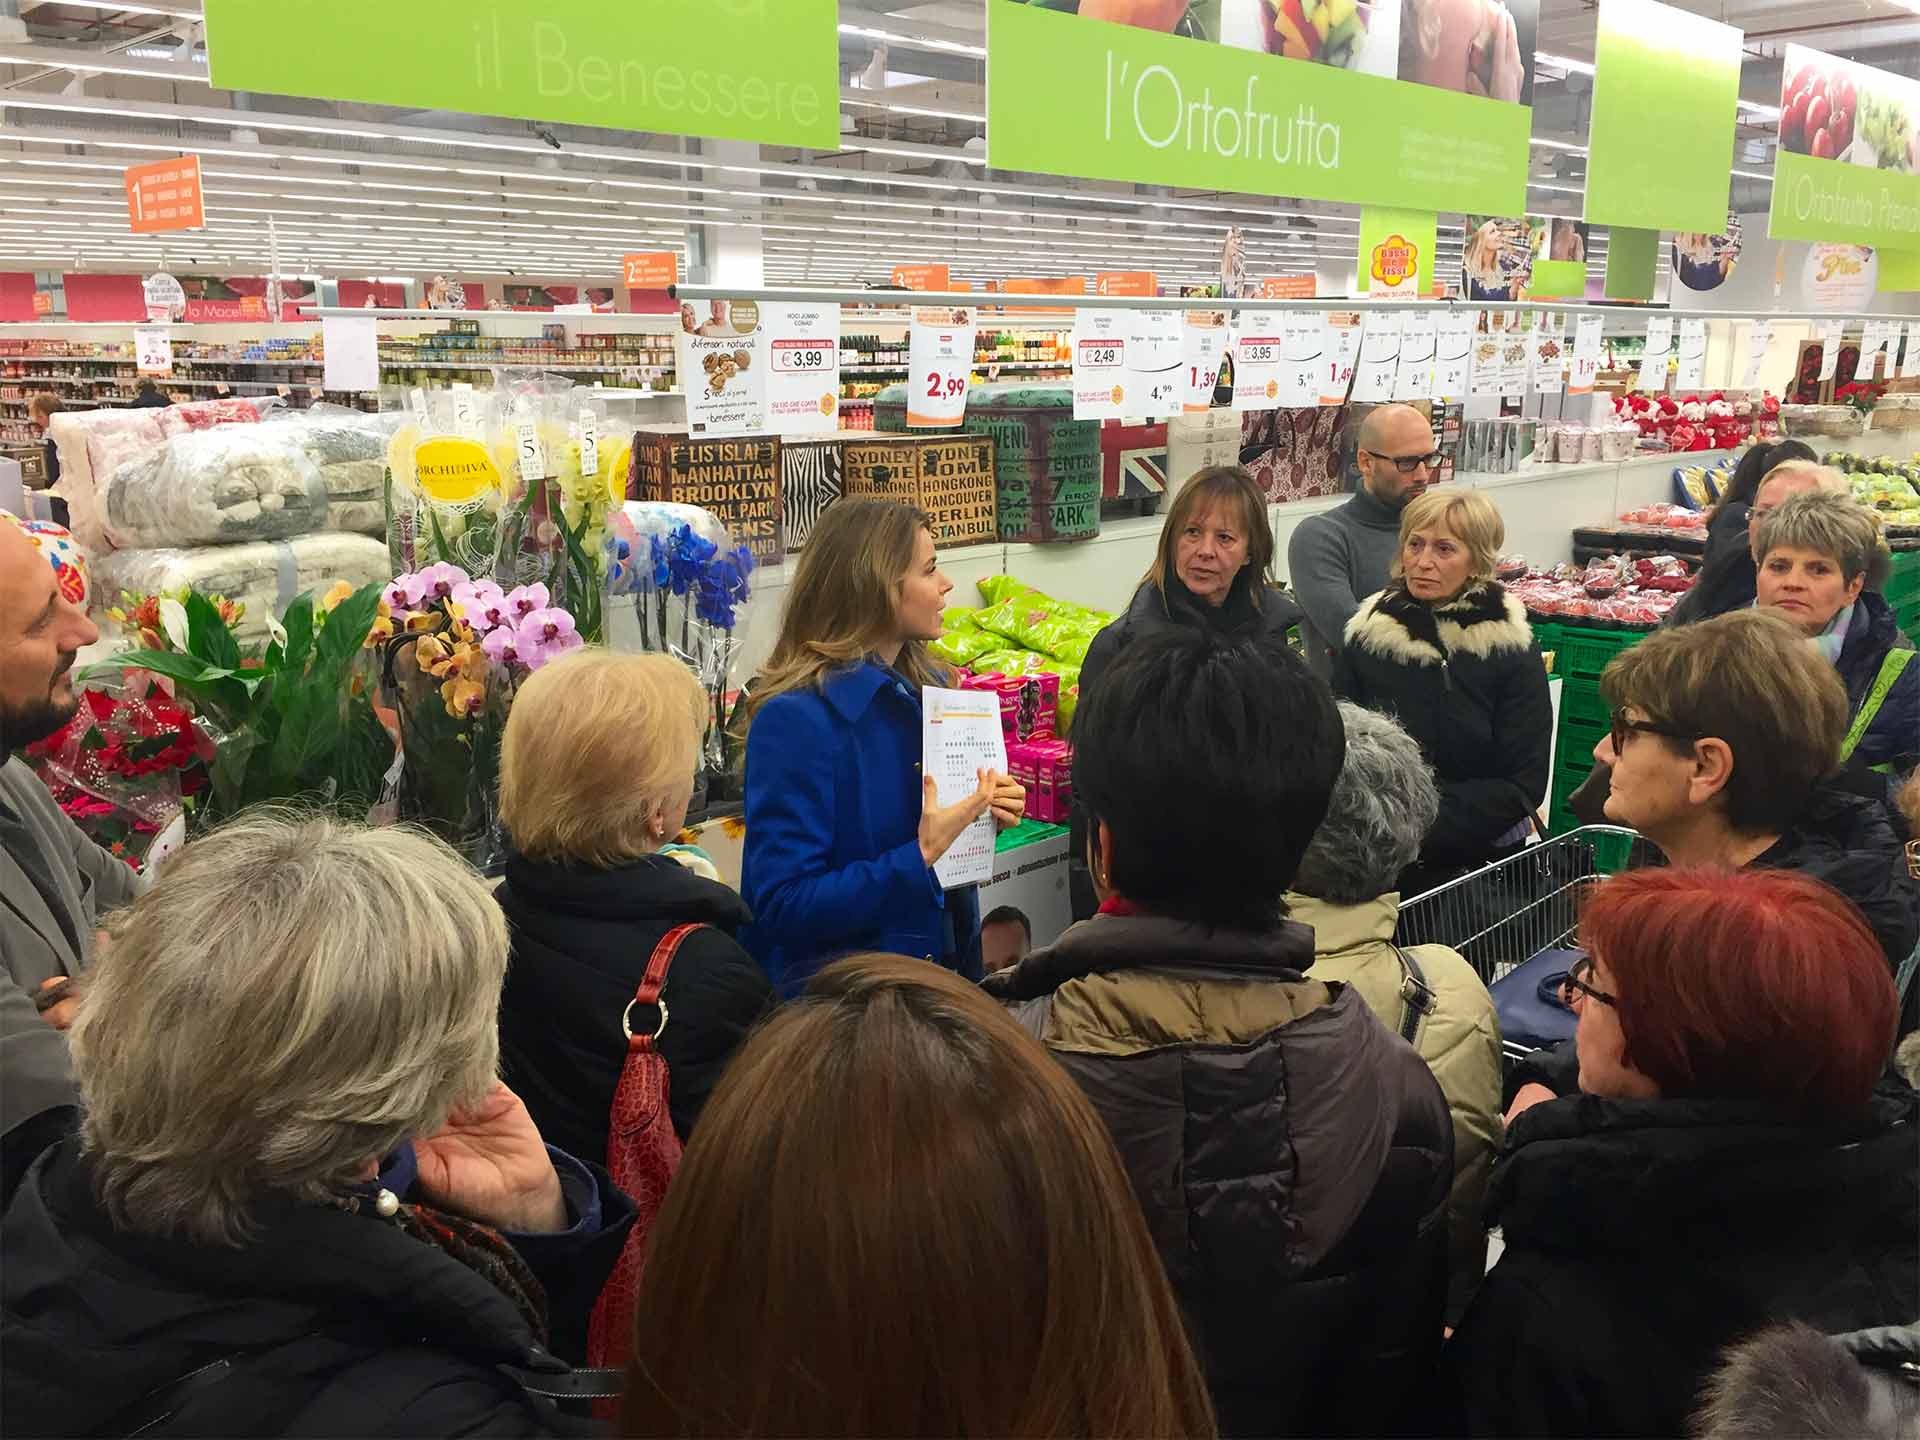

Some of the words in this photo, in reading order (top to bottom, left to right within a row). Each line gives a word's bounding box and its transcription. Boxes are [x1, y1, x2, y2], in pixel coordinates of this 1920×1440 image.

[472, 13, 502, 90] il
[534, 20, 821, 127] Benessere
[1105, 49, 1341, 170] l'Ortofrutta
[131, 181, 143, 221] 1
[626, 262, 636, 283] 2
[1098, 278, 1109, 295] 4
[1266, 284, 1275, 298] 5
[793, 351, 822, 368] 3,99
[1094, 349, 1115, 365] 2,49
[1251, 346, 1272, 361] 3,95
[1190, 366, 1217, 390] 1,39
[1330, 363, 1352, 384] 1,49
[926, 372, 965, 400] 2,99
[521, 439, 536, 459] 5
[582, 431, 594, 452] 5
[847, 450, 914, 465] SYDNEY
[416, 461, 489, 476] ORCHIDIVA
[671, 463, 776, 484] MANHATTAN
[671, 481, 777, 502] BROOKLYN
[923, 475, 993, 493] HONGKONG
[924, 490, 993, 508] VANCOUVER
[740, 502, 775, 518] PARK
[928, 504, 994, 523] BERLIN
[930, 520, 994, 540] STANBUL
